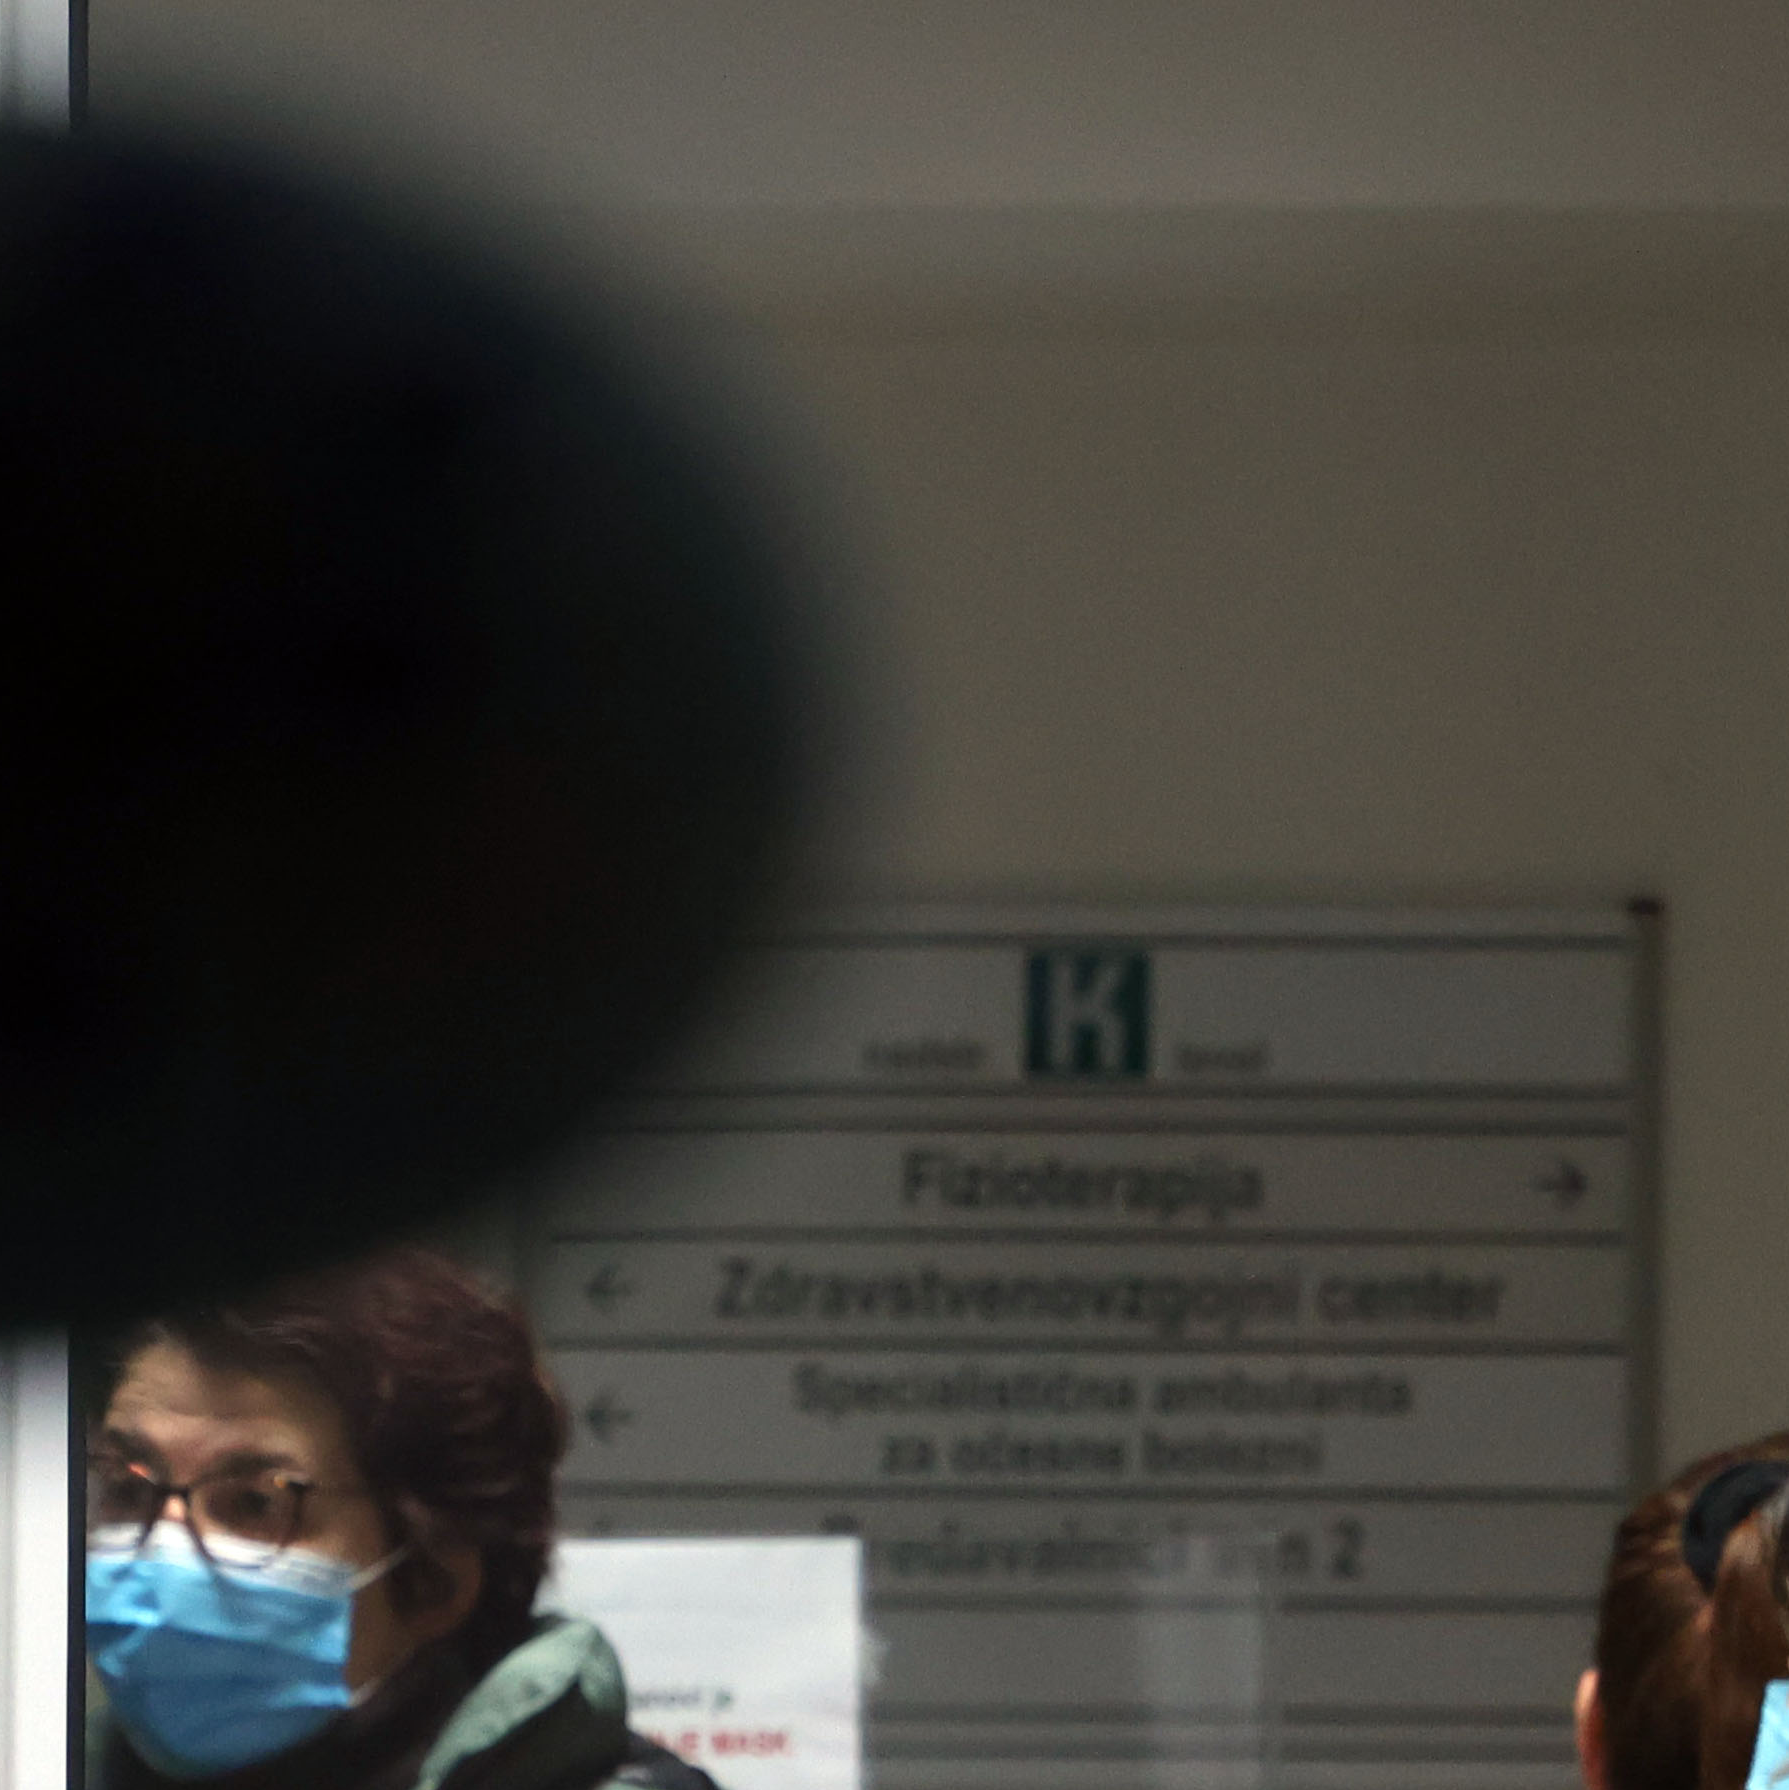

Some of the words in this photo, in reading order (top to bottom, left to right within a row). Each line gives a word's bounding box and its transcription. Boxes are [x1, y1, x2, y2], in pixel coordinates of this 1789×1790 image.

[902, 1149, 1264, 1224] Fizioterapija
[715, 1257, 1299, 1342] Zdravstvenovzgojni
[1316, 1270, 1506, 1324] center
[794, 1364, 1139, 1424] Specialistična
[1155, 1367, 1411, 1413] ambulanta
[881, 1437, 938, 1475] za
[949, 1428, 1126, 1475] očesne
[1141, 1429, 1323, 1475] bolezni
[1331, 1516, 1366, 1580] 2
